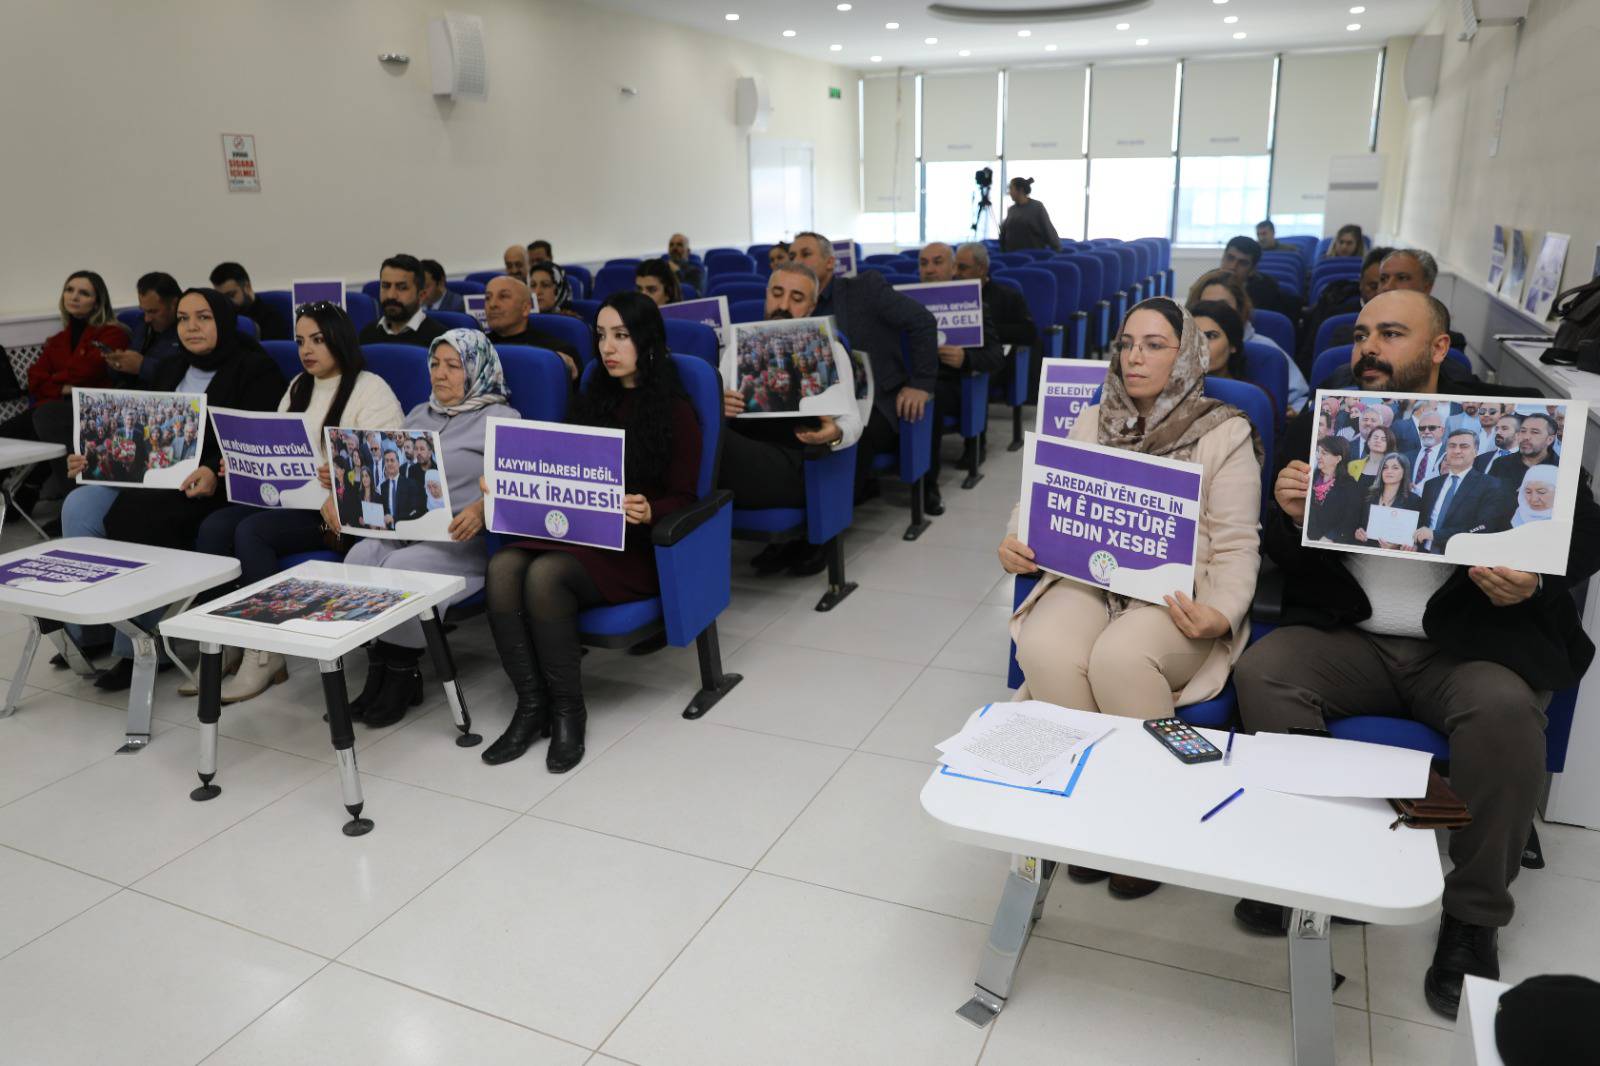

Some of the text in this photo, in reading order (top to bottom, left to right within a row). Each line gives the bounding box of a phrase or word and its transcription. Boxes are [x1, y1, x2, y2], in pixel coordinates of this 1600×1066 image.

[226, 453, 317, 477] İRADEYA GEL!
[498, 457, 536, 473] KAYYIM
[539, 460, 580, 478] İDARESİ
[496, 479, 621, 510] HALK İRADESİ!
[1046, 472, 1184, 515] ŞAREDARÎ YÊN GEL İN
[1047, 491, 1177, 539] EM Ê DESTÛRÊ
[1050, 514, 1169, 560] NEDIN XESBÊ
